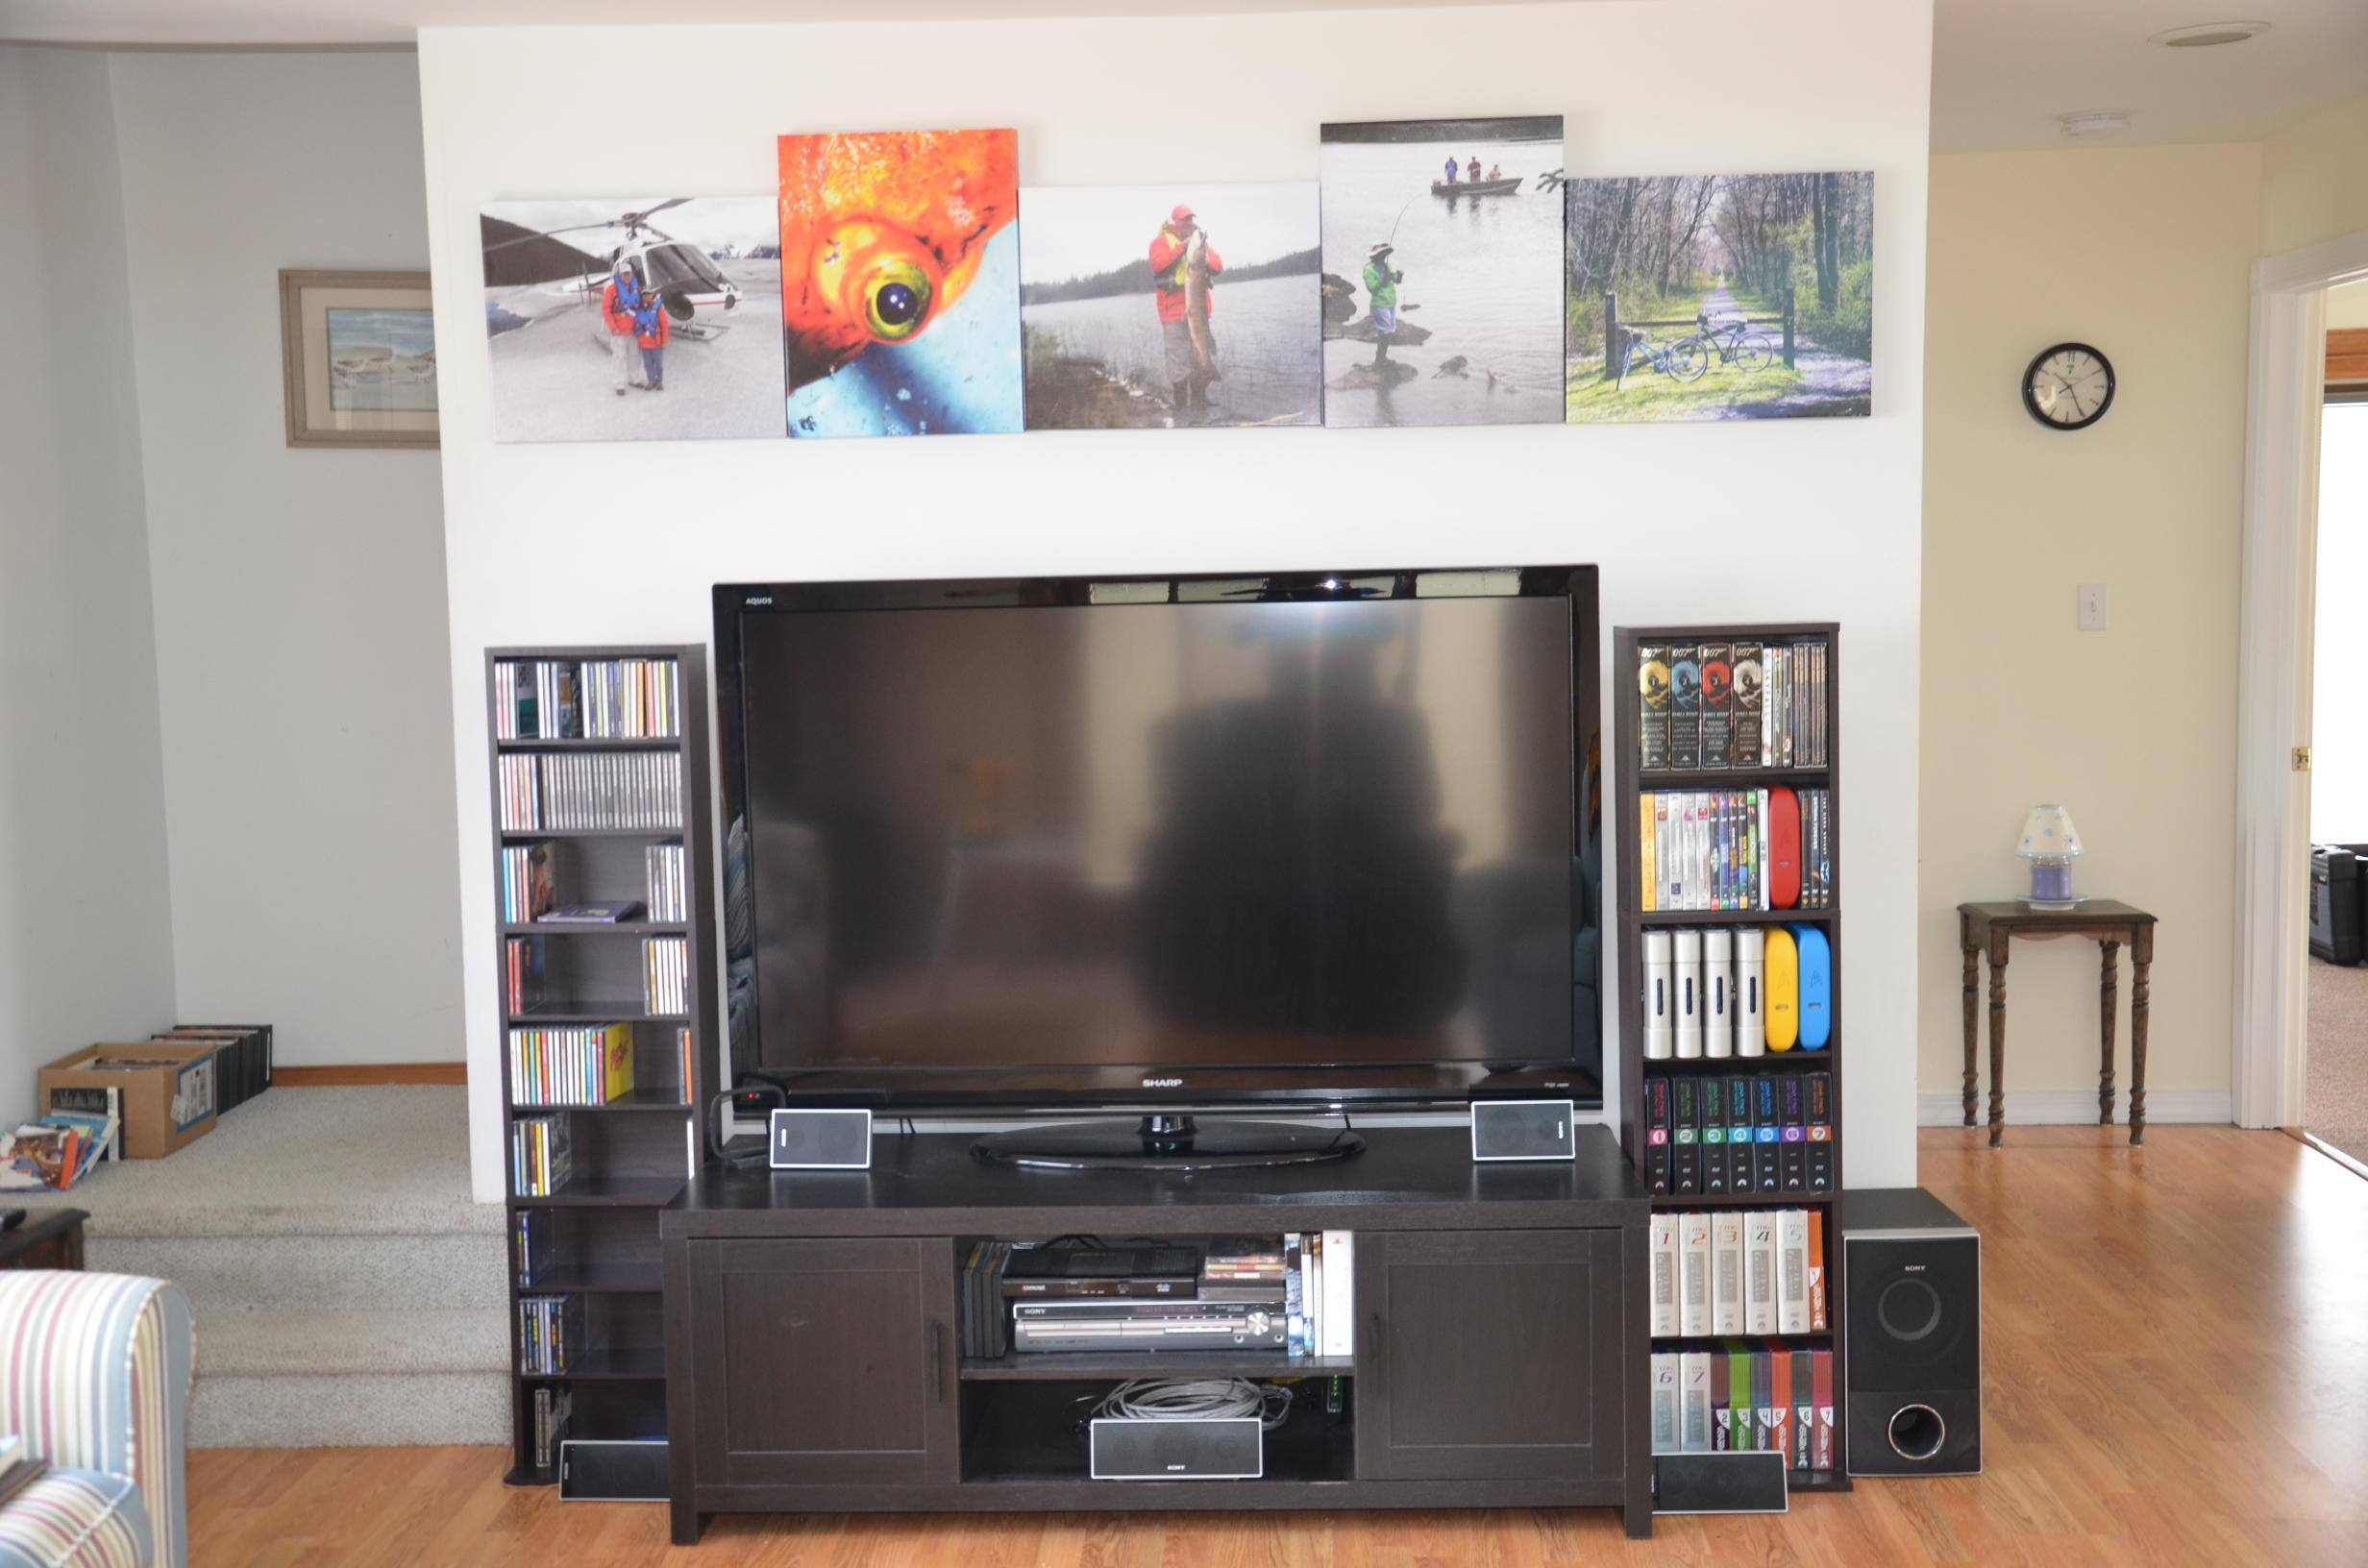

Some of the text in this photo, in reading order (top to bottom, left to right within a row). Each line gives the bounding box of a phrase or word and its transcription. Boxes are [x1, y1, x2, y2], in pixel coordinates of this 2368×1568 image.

[746, 597, 773, 605] AQUOS
[1641, 648, 1665, 657] 007
[1673, 648, 1695, 657] 007
[1704, 648, 1727, 657] 007
[1736, 648, 1759, 657] 007
[1142, 1078, 1183, 1087] SHARP
[1663, 1233, 1669, 1244] 1
[1691, 1232, 1707, 1245] 2
[1756, 1231, 1770, 1242] 4
[1659, 1371, 1672, 1384] 6
